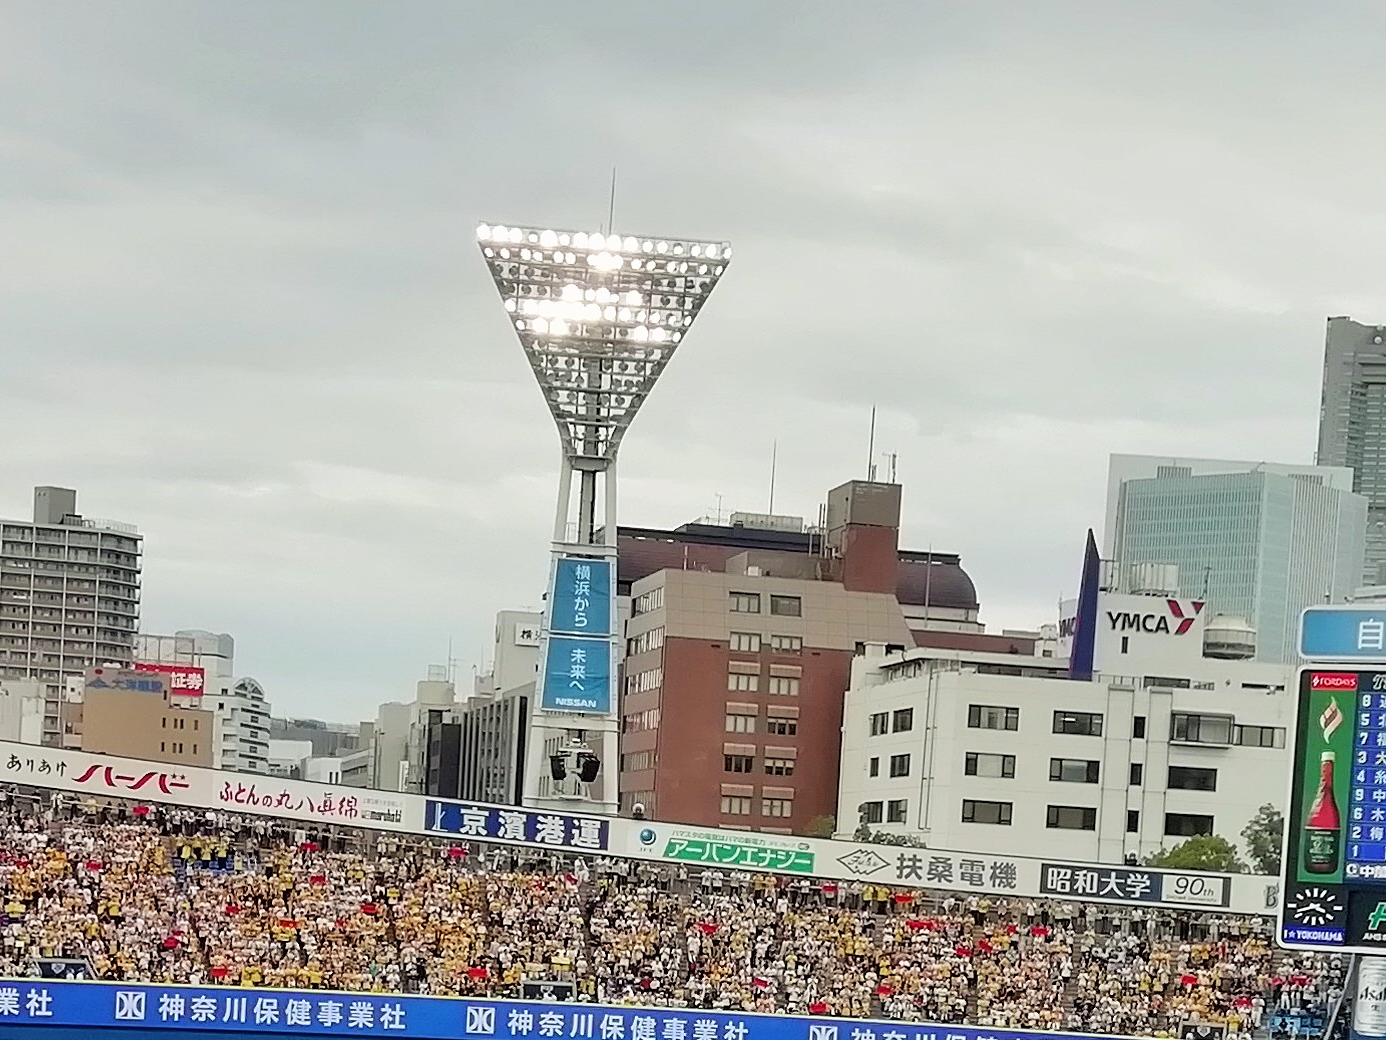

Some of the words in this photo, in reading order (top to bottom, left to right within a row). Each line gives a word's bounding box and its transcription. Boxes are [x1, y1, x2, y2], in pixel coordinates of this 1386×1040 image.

[574, 564, 591, 627] 横浜から
[1107, 611, 1170, 634] YMCA
[569, 648, 587, 691] 未来へ
[555, 697, 596, 708] NISSAN
[1363, 695, 1371, 707] 8
[1361, 714, 1370, 726] 5
[1360, 733, 1369, 745] 7
[1357, 752, 1367, 764] 3
[6, 753, 67, 778] ありあけ
[1356, 770, 1366, 782] 4
[1355, 789, 1364, 801] 9
[1354, 808, 1363, 819] 6
[1352, 826, 1361, 838] 2
[669, 839, 811, 868] アーバンエナジー
[1352, 845, 1359, 857] 1
[895, 852, 1017, 890] 扶桑電機
[1047, 867, 1151, 898] 昭和大学
[1174, 877, 1214, 896] 90th
[1297, 930, 1343, 942] YOKOHAMA
[159, 994, 407, 1031] 神奈川保健事業社
